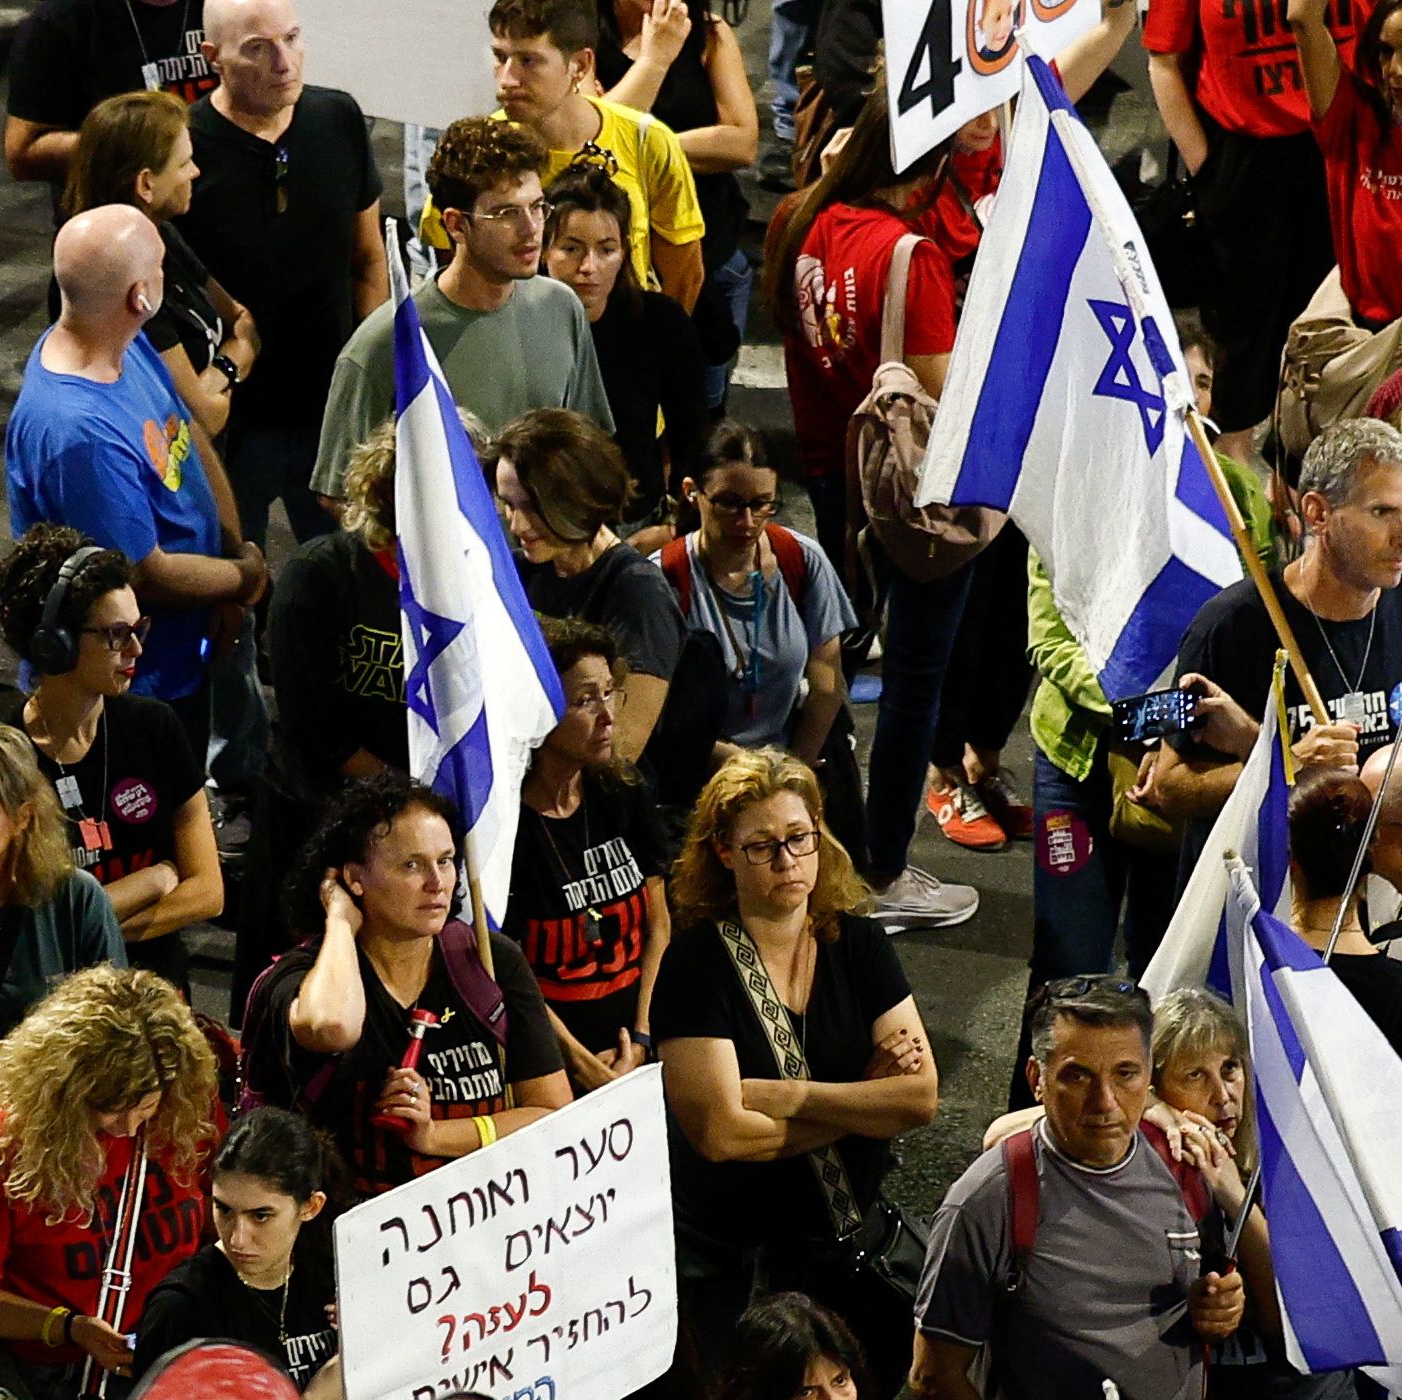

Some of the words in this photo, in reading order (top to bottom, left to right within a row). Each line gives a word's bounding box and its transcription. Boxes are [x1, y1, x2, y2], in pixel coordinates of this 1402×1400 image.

[894, 0, 1077, 117] 40
[561, 872, 613, 912] הביתה
[457, 1068, 503, 1102] אותם
[554, 1117, 634, 1181] סער
[380, 1168, 529, 1267] ואוחנה
[505, 1187, 617, 1273] יוצאים
[407, 1265, 462, 1316] גם
[437, 1269, 552, 1363] לעזה?
[527, 1276, 653, 1363] להחזיר
